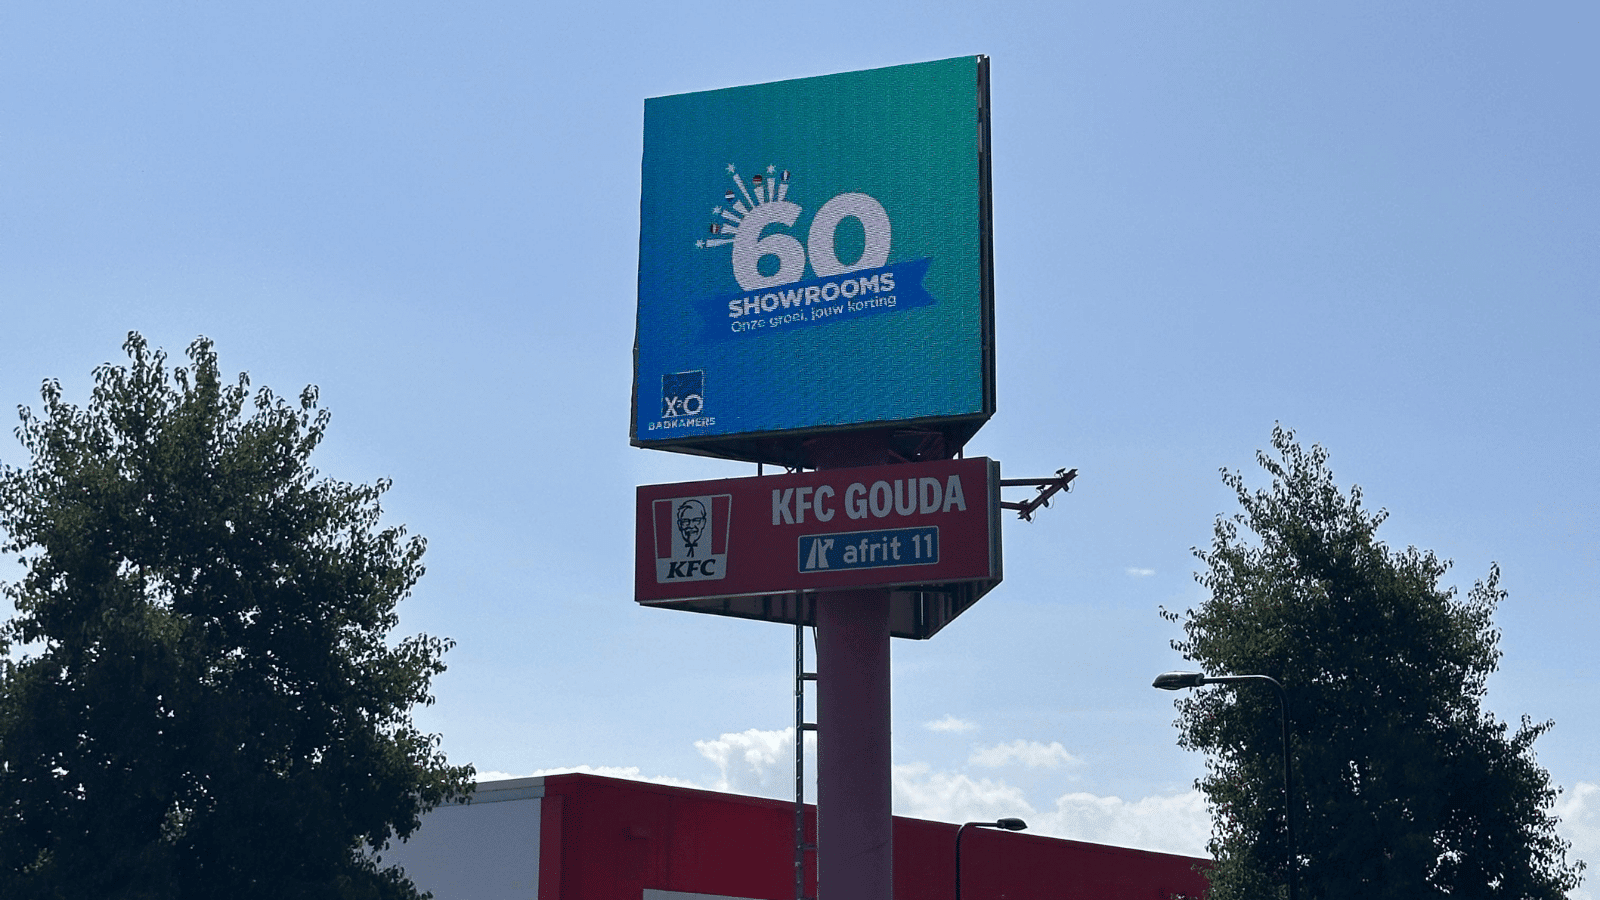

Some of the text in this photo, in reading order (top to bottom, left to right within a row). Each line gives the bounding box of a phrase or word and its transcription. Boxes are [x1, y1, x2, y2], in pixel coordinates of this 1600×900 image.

[732, 192, 891, 291] 60
[728, 272, 896, 318] SHOWROOMS
[731, 294, 897, 333] Onze groei, jouw korting
[648, 416, 716, 431] BADKAMERS
[771, 474, 967, 525] KFC GOUDA
[843, 532, 933, 565] afrit 11
[667, 558, 717, 580] KFC
